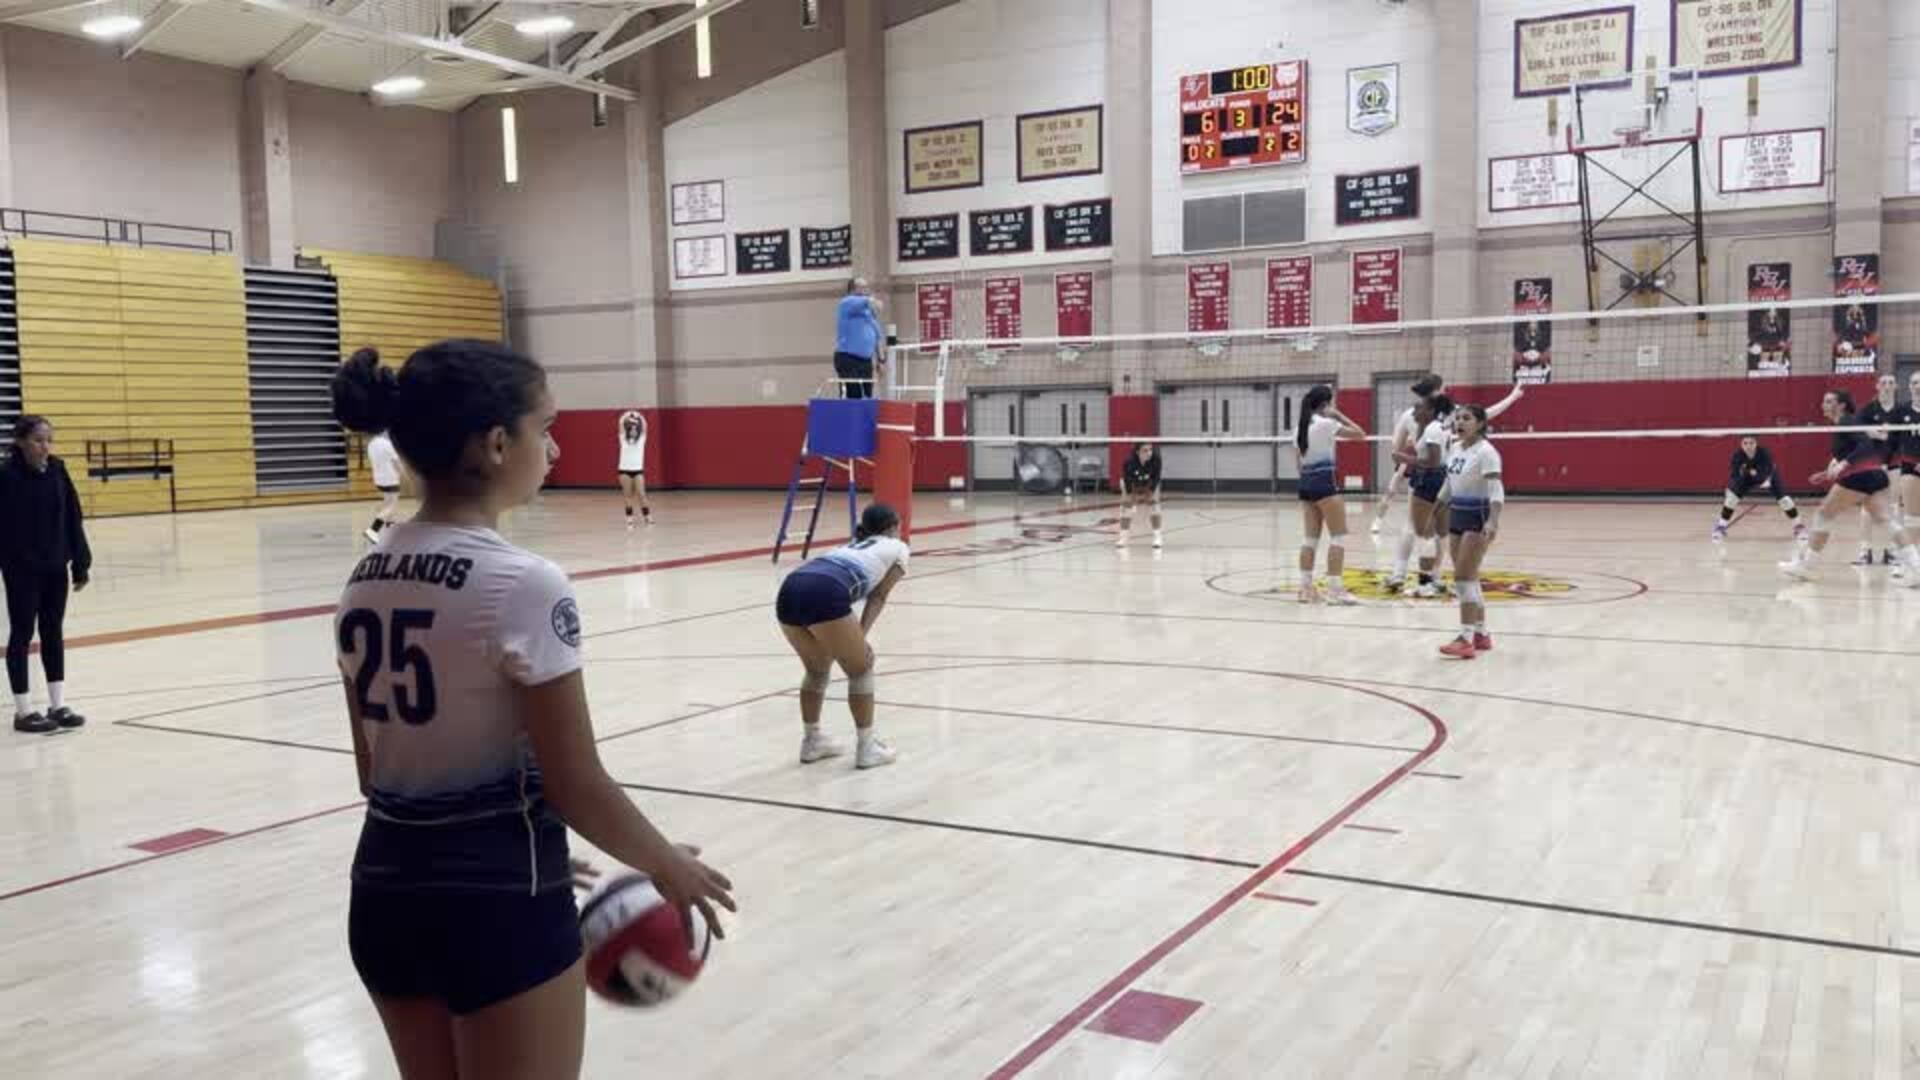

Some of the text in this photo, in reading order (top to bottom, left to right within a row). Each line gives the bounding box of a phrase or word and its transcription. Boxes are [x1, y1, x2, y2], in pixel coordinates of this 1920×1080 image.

[1707, 32, 1763, 48] WRESTLING
[1559, 51, 1617, 67] VOLLEYBALL
[1232, 66, 1269, 90] 1:00
[1201, 111, 1213, 133] 6
[1235, 109, 1246, 127] 3
[1272, 101, 1299, 125] 24
[1188, 145, 1199, 161] 0
[339, 608, 436, 725] 25
